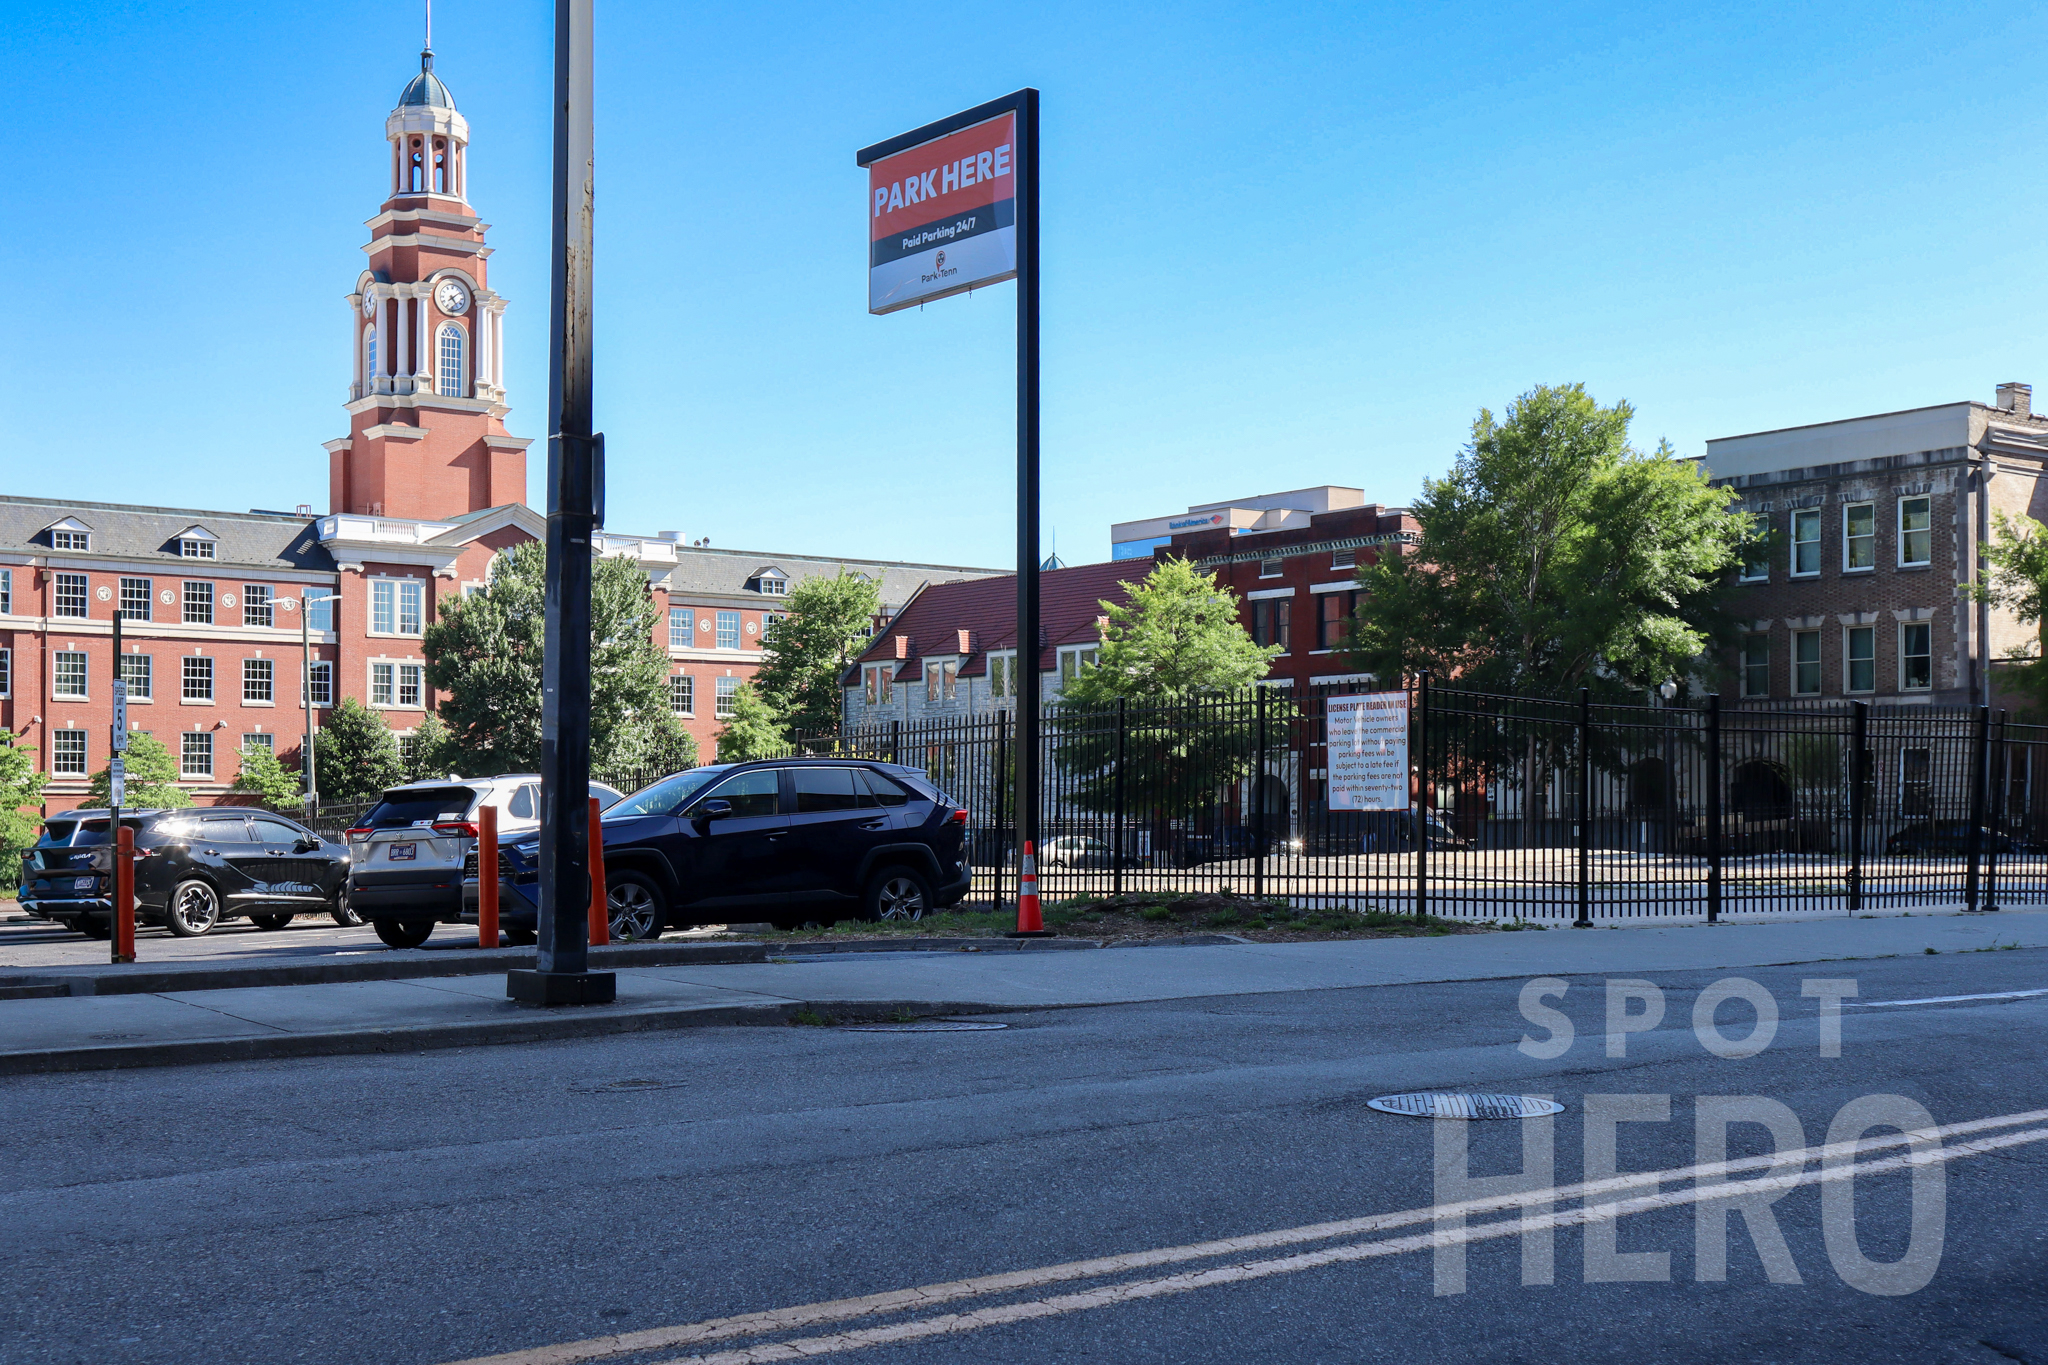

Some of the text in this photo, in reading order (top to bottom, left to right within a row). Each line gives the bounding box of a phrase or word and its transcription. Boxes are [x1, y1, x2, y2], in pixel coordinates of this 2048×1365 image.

[875, 144, 1010, 218] PARK HERE
[902, 217, 976, 250] Paid Parking 24/7
[1329, 704, 1349, 712] LICENSE
[1350, 702, 1365, 711] PLATE
[1366, 701, 1387, 710] READER
[1395, 700, 1406, 708] USE
[117, 709, 122, 731] 5
[1329, 740, 1351, 748] parking
[1385, 738, 1406, 746] paying
[1338, 751, 1360, 759] parking
[1336, 762, 1357, 771] subject
[1332, 785, 1345, 793] paid
[1365, 784, 1402, 792] seventy-two
[1352, 796, 1363, 804] (72)
